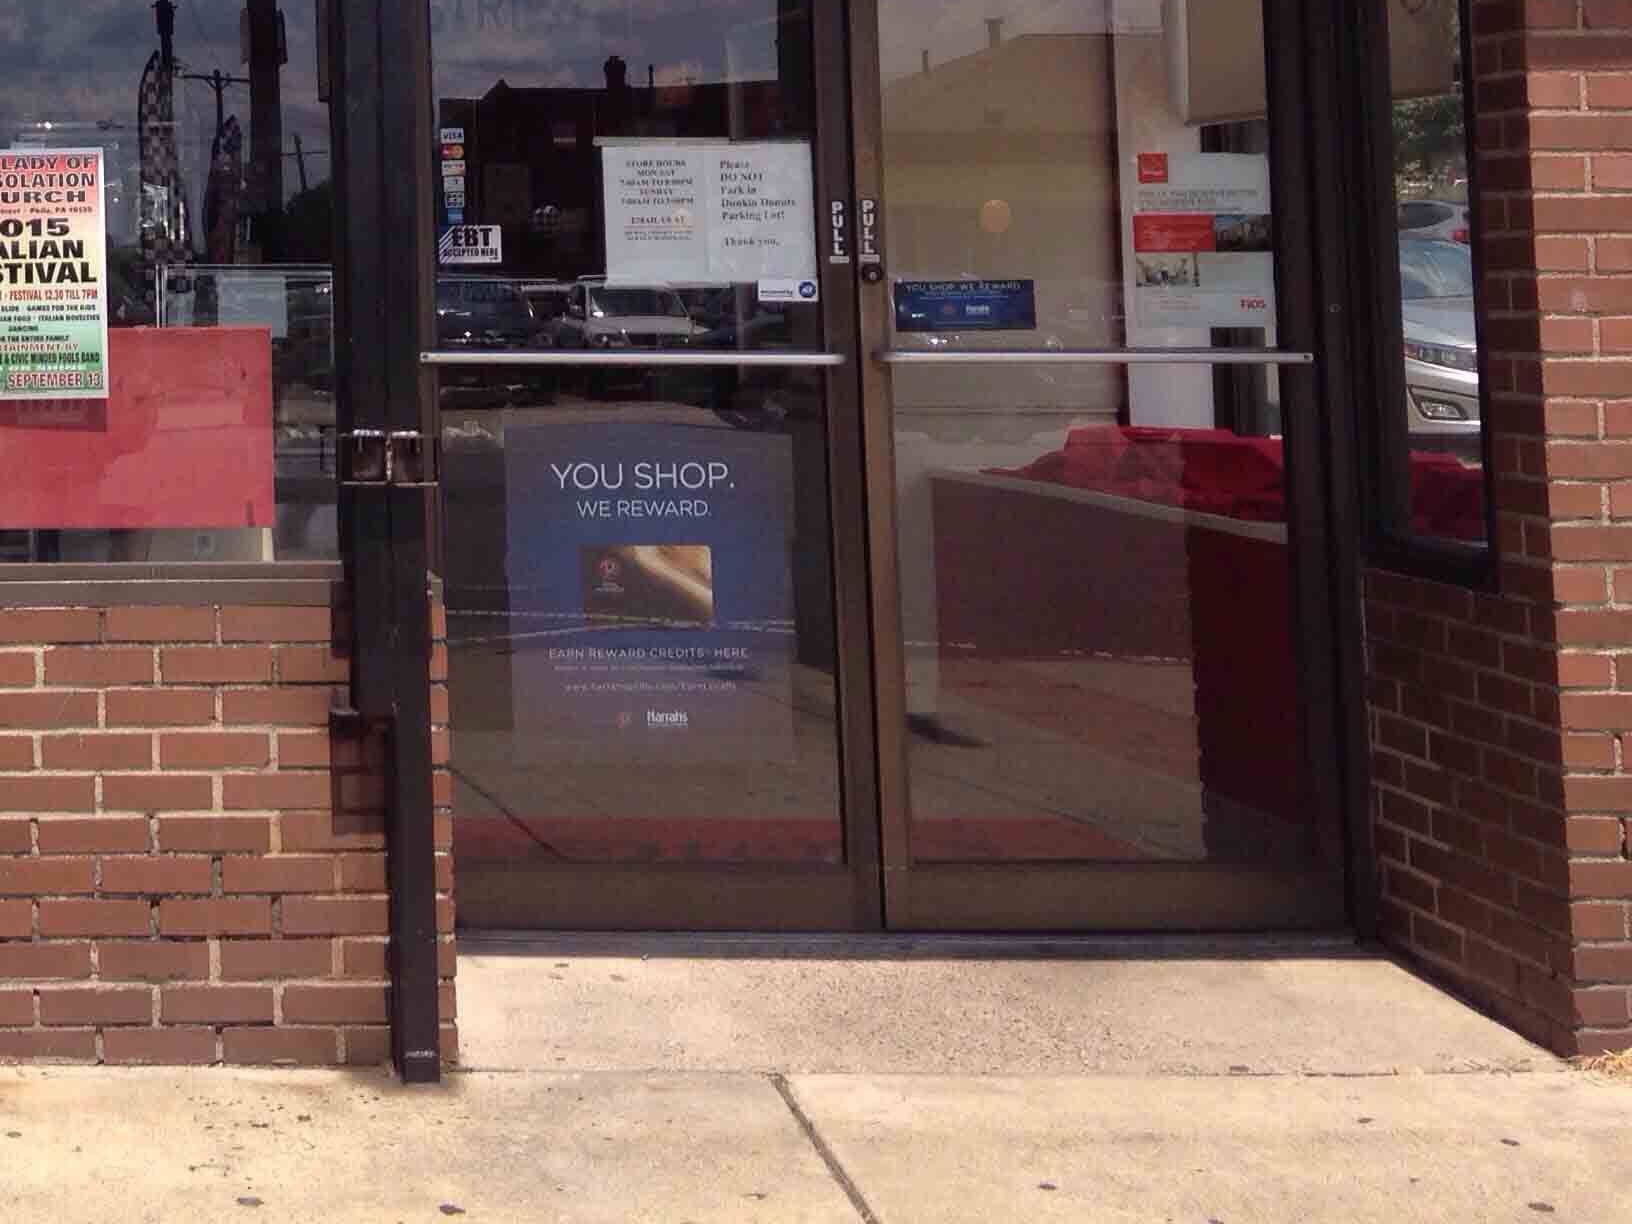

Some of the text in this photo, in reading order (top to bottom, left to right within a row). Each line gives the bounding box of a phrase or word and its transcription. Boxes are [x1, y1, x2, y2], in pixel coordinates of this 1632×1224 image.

[1, 157, 57, 170] LADY
[67, 156, 96, 169] OF
[831, 201, 844, 255] PULL
[862, 199, 875, 254] PULL
[451, 227, 493, 247] EBT
[9, 289, 42, 301] FESTIVAL
[65, 289, 80, 300] TILL
[82, 289, 98, 300] 7PM
[7, 374, 82, 388] SEPTEMBER
[550, 462, 736, 489] YOU SHOP.
[576, 499, 712, 518] WE REWARD.
[548, 647, 585, 659] EARN
[588, 647, 646, 659] REWARD
[714, 647, 749, 659] HERE
